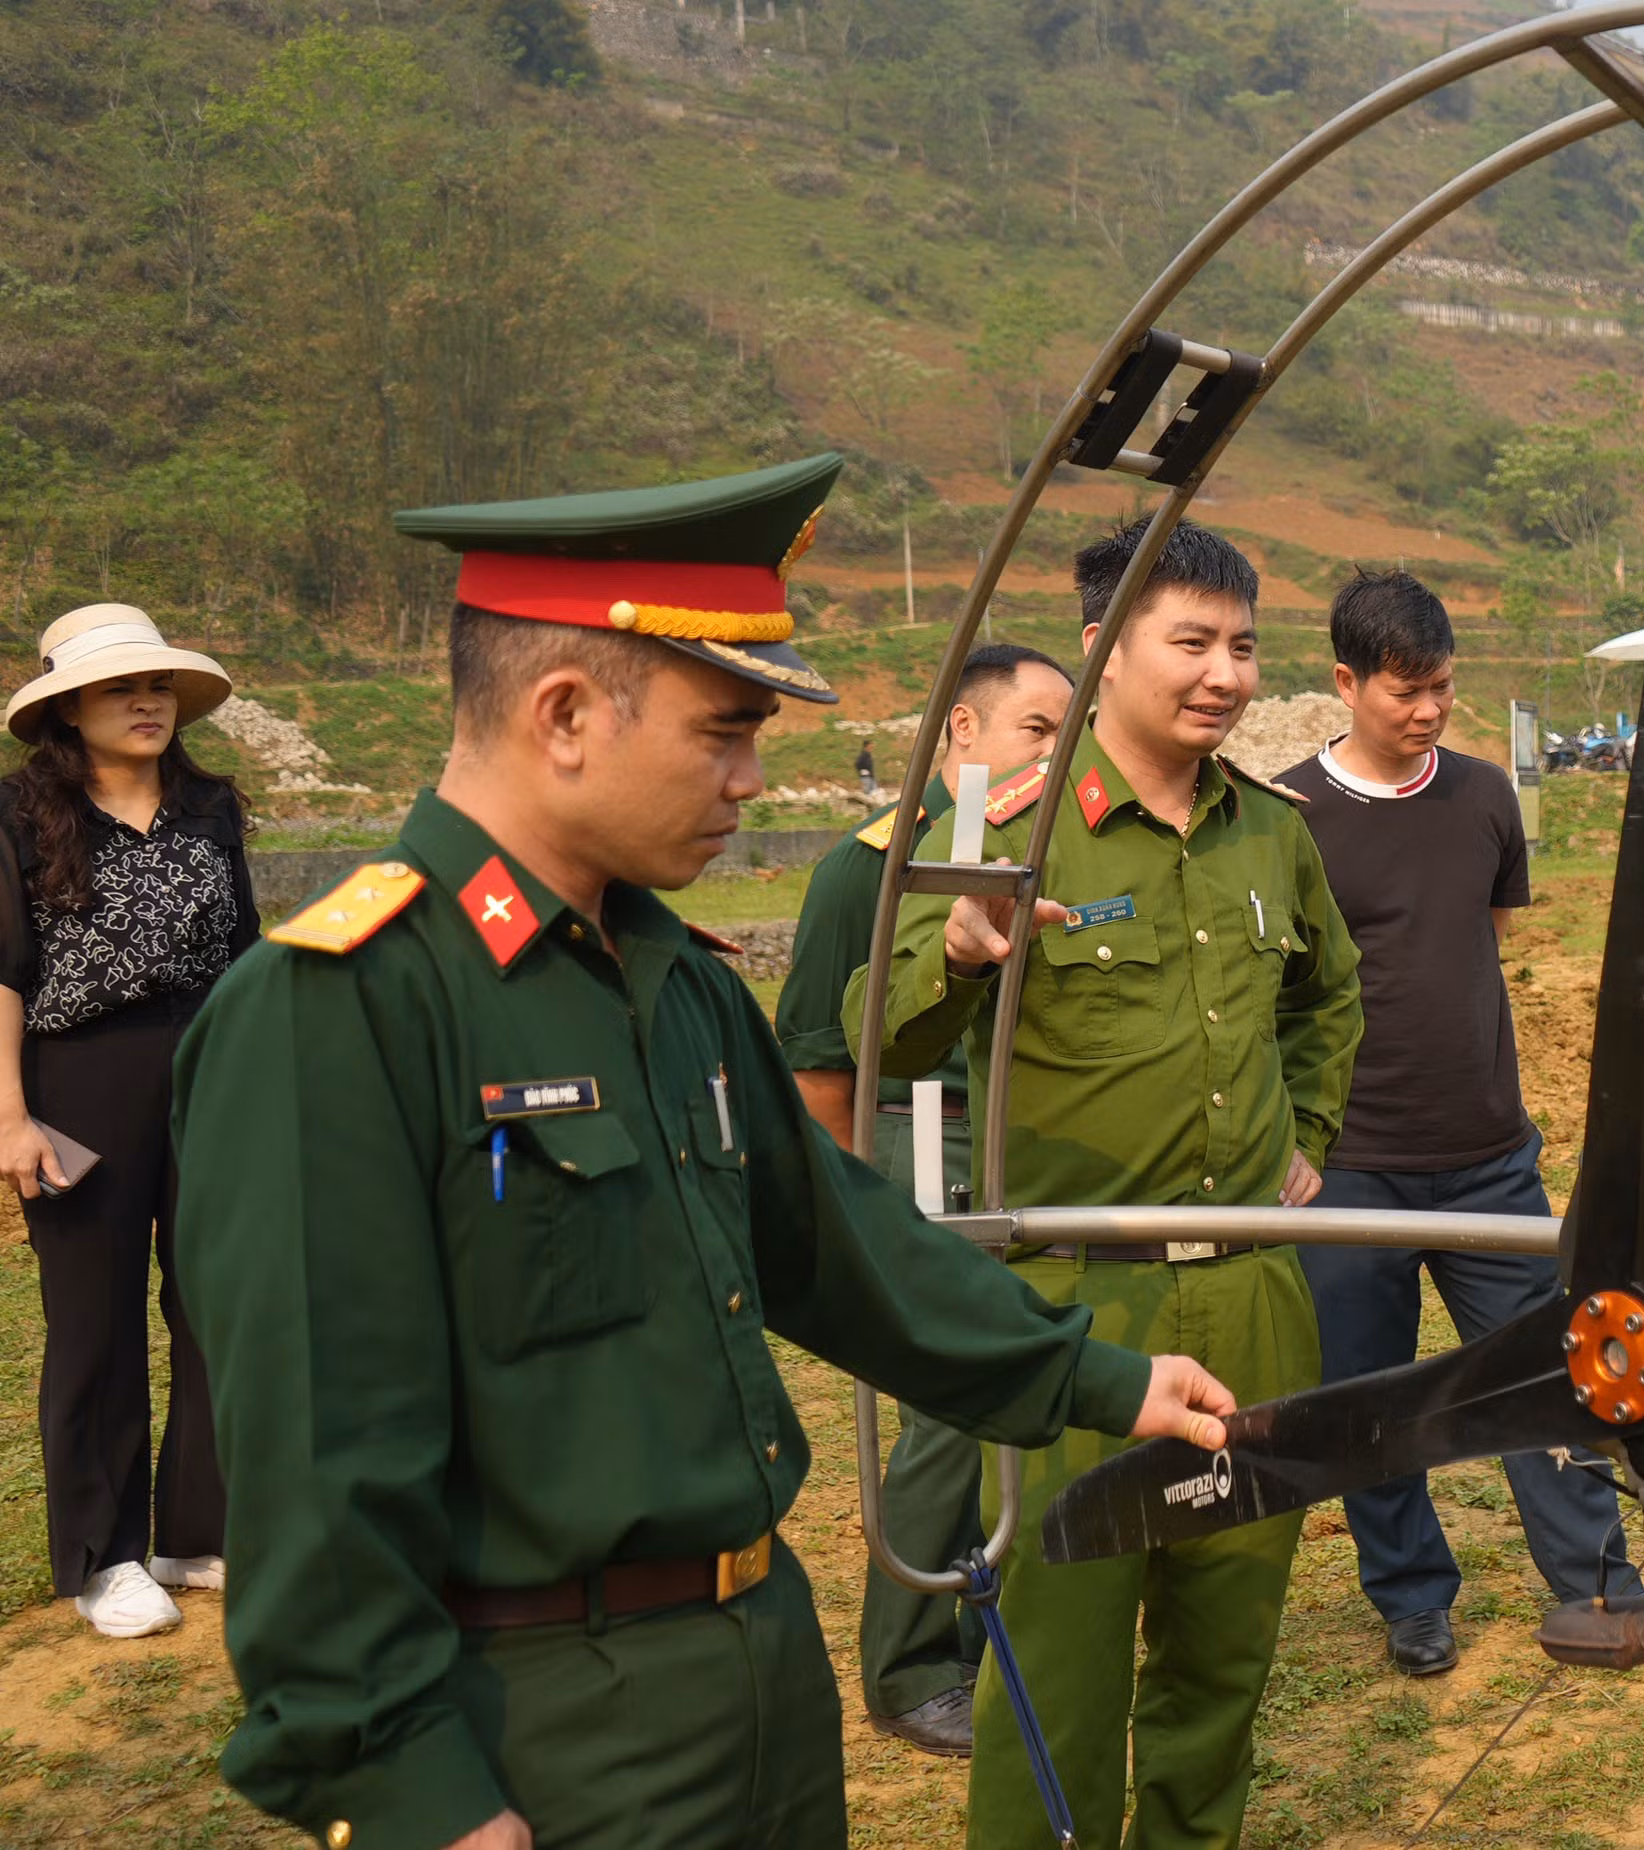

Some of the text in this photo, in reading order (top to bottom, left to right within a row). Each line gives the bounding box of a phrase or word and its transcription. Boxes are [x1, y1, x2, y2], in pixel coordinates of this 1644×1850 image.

[1326, 777, 1370, 804] TOMMY HILFIGER
[1192, 1492, 1216, 1510] MOTORS
